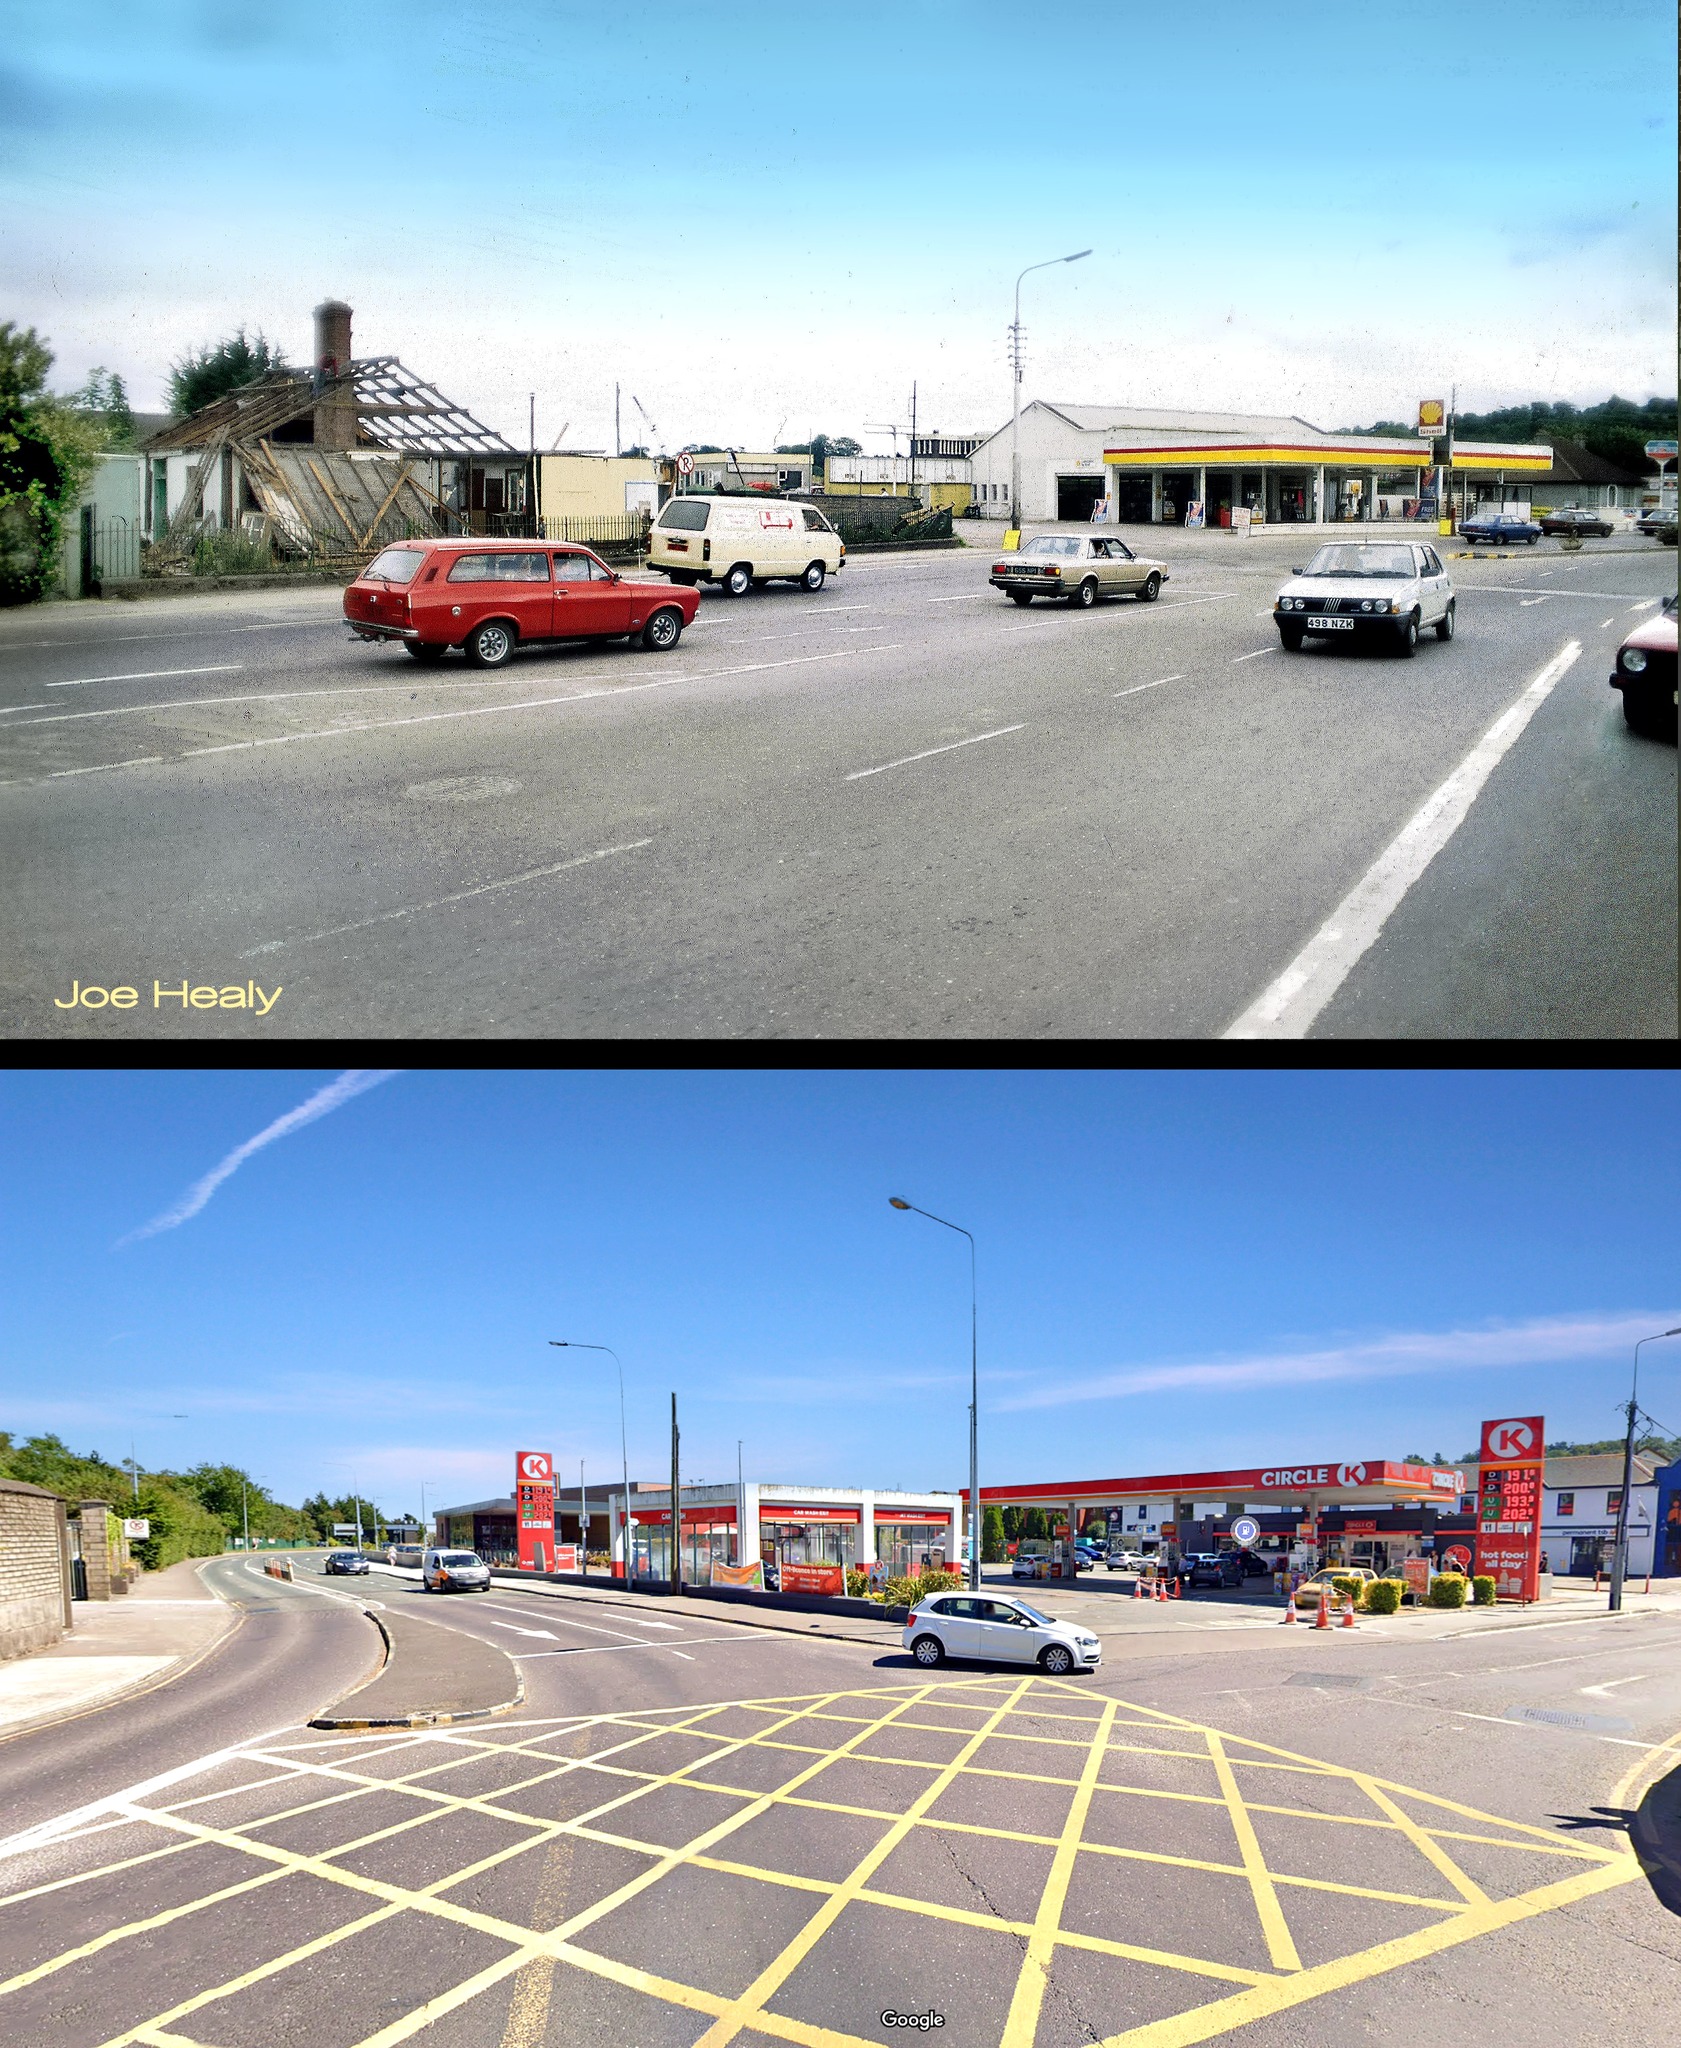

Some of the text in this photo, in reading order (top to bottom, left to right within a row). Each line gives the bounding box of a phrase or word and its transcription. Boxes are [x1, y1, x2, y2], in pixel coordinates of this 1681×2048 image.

[1308, 619, 1354, 628] 498 NZK
[1494, 1424, 1529, 1457] K
[528, 1458, 547, 1478] K
[1261, 1463, 1365, 1487] CIRCLE K
[1480, 1551, 1528, 1559] hot food
[1485, 1559, 1522, 1569] all day
